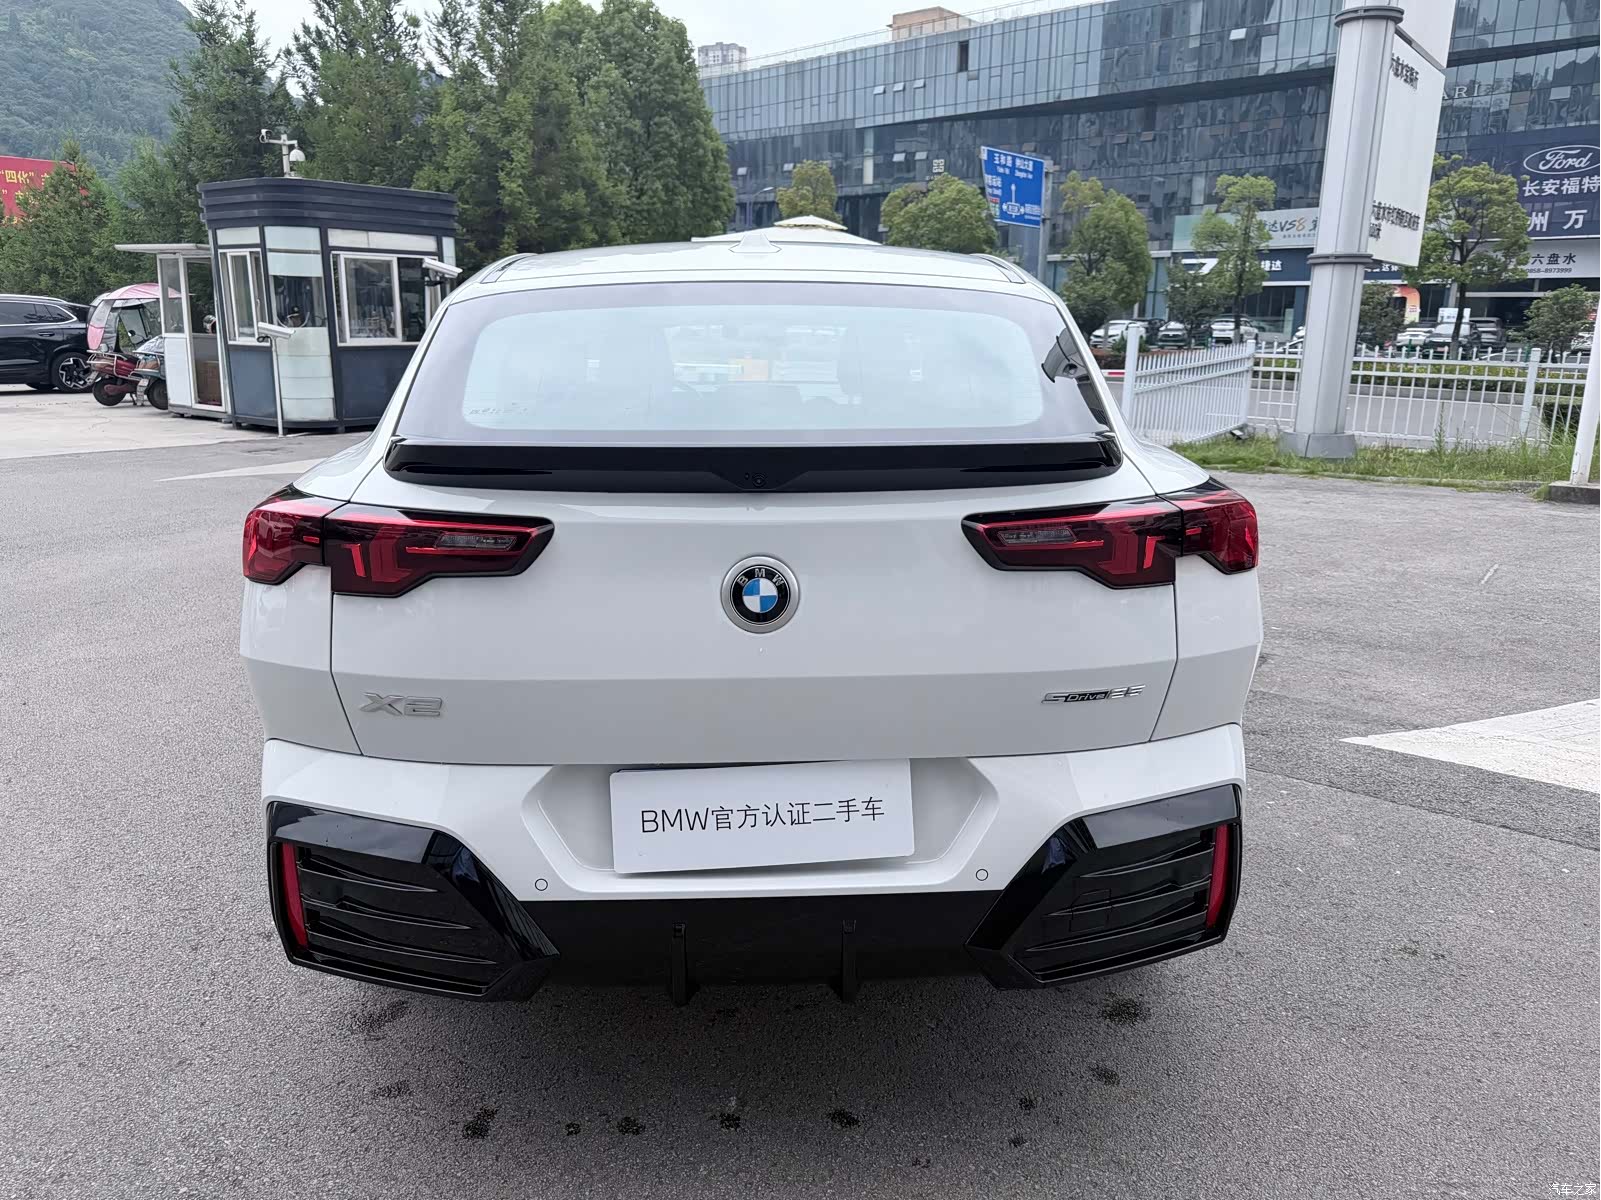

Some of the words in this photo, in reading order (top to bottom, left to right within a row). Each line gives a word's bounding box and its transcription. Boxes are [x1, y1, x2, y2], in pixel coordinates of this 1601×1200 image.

[1539, 149, 1593, 170] Ford
[1522, 175, 1600, 197] 长安福特
[1531, 253, 1577, 265] 六盘水
[736, 568, 786, 587] BMW
[360, 692, 443, 717] X2
[640, 796, 885, 833] BMW官方认证二手车
